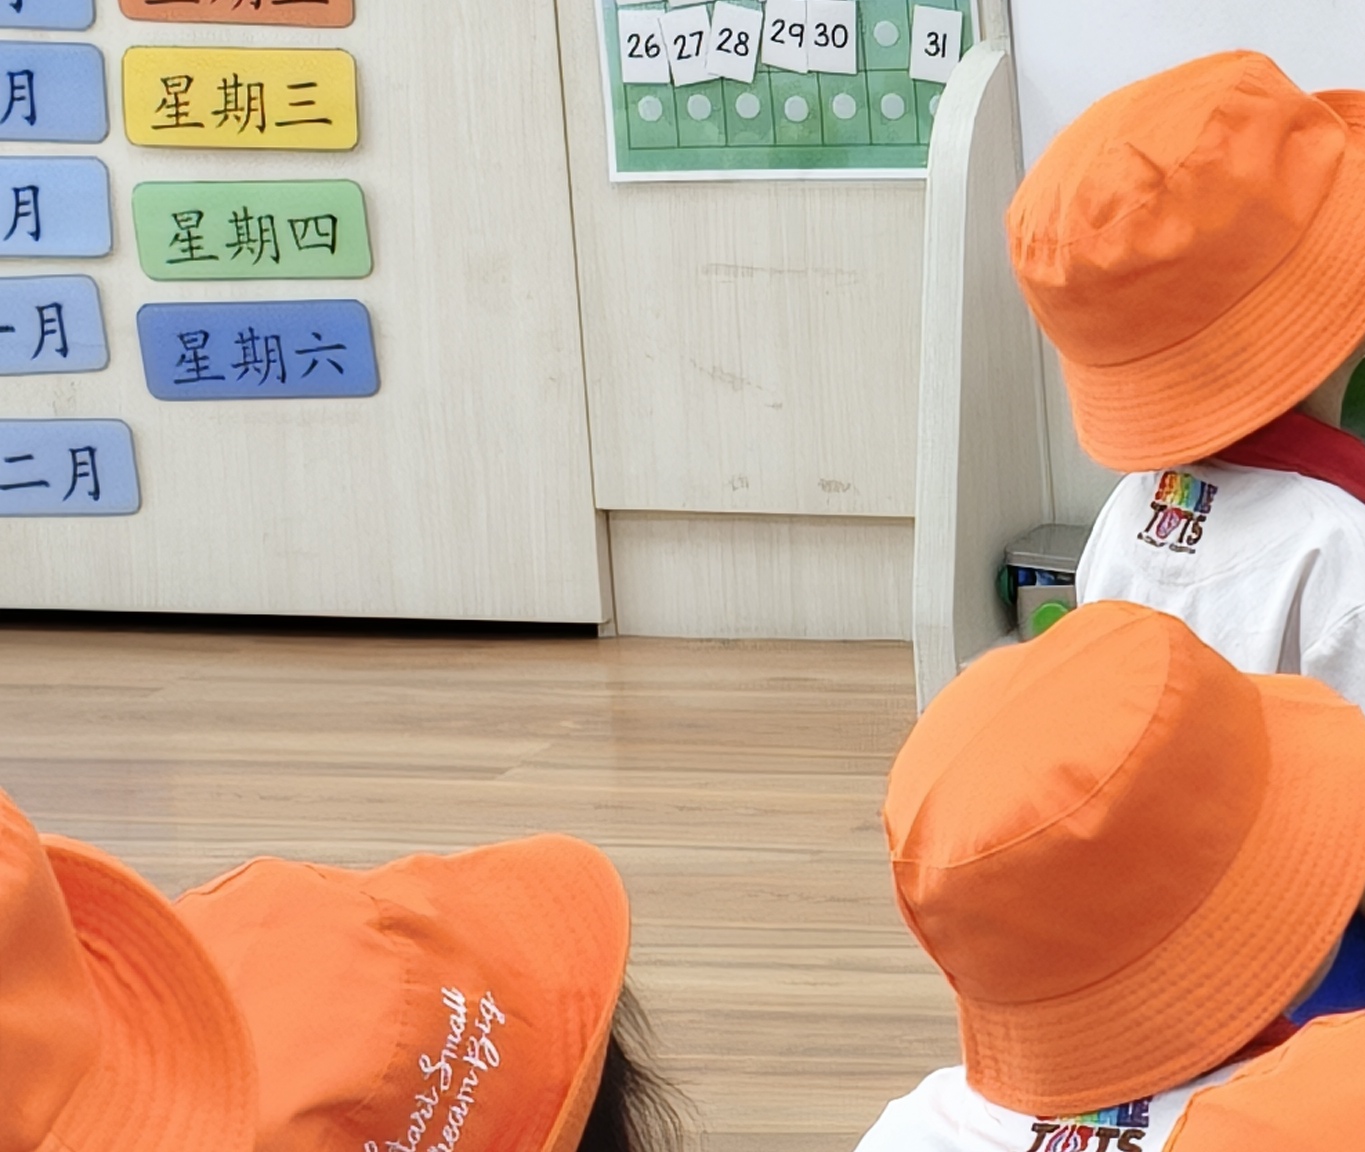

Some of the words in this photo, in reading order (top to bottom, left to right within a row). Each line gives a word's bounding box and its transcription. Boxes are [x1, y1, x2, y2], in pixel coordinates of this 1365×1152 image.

[627, 33, 661, 59] 26
[673, 30, 704, 61] 27
[716, 27, 750, 57] 28
[770, 18, 805, 48] 29
[814, 22, 849, 49] 30
[924, 31, 947, 58] 31
[151, 72, 333, 134] 星期三
[166, 206, 338, 265] 星期四
[173, 326, 347, 385] 星期六
[418, 987, 468, 1093] Small
[426, 1069, 479, 1152] ream
